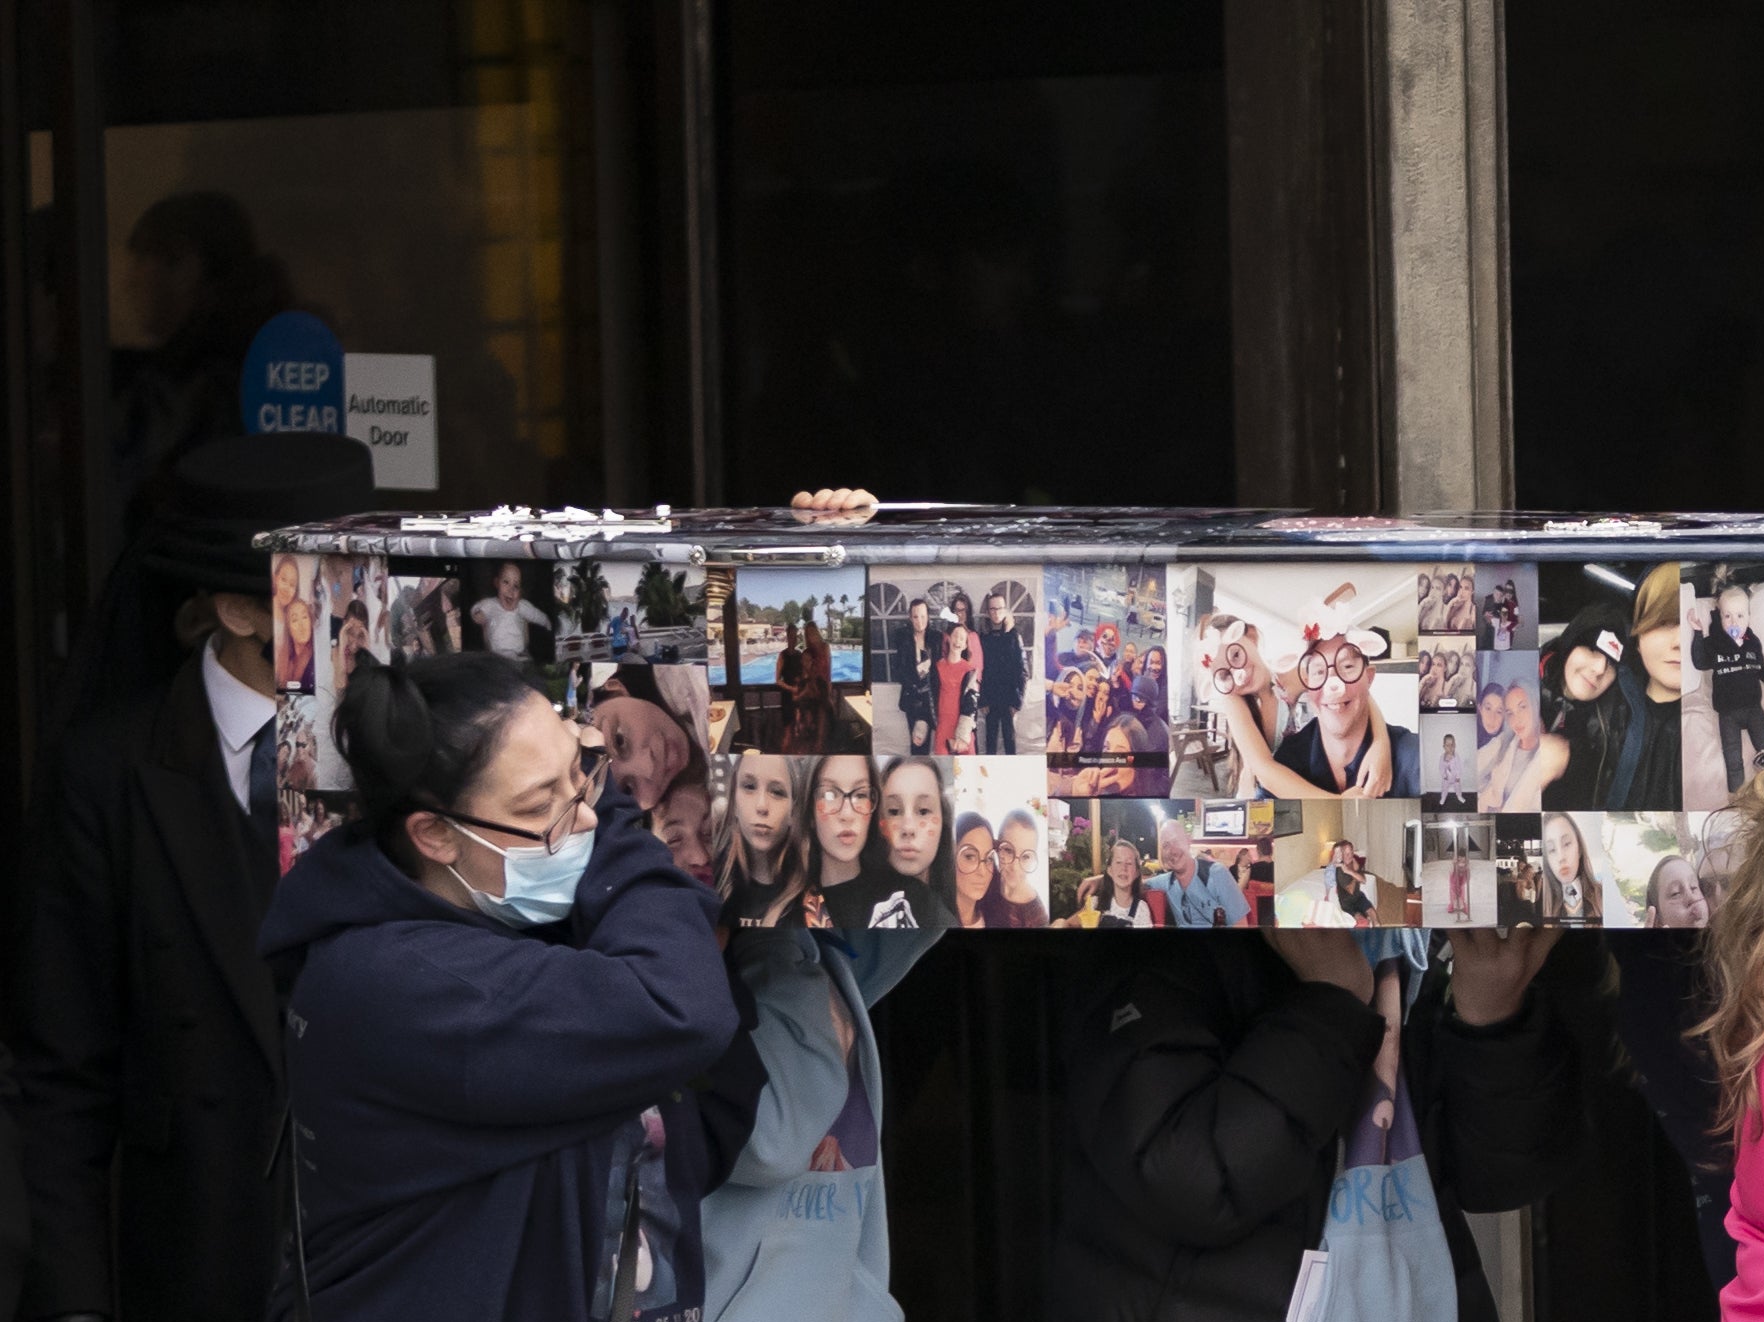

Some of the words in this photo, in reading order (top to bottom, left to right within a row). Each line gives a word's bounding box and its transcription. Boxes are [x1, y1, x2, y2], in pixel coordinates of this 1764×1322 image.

[266, 361, 330, 390] KEEP
[350, 394, 430, 415] Automatic
[258, 403, 338, 432] CLEAR
[370, 426, 409, 445] Door
